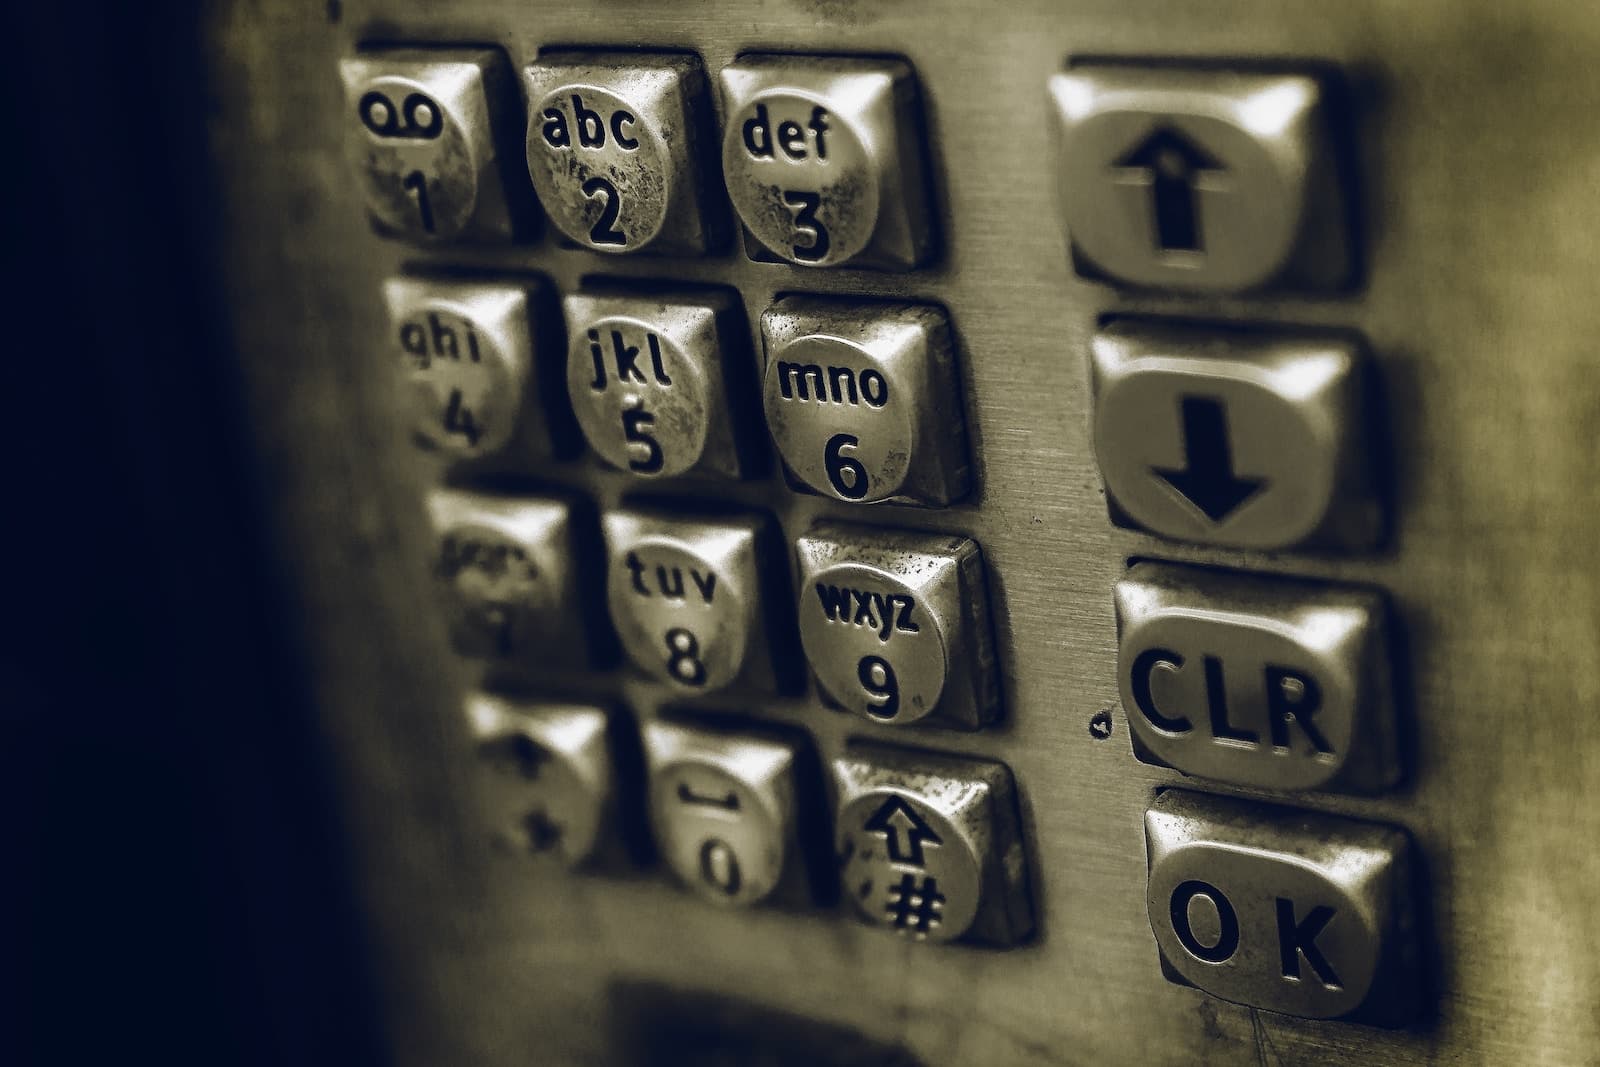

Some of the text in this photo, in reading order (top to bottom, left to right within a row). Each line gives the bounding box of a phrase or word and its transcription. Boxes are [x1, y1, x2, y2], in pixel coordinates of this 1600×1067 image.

[543, 94, 639, 149] abc
[743, 104, 830, 162] def
[403, 171, 436, 234] 1
[582, 177, 626, 245] 2
[784, 190, 830, 262] 3
[401, 312, 481, 370] ghi
[588, 328, 671, 390] jkl
[778, 361, 888, 408] mno
[445, 387, 481, 446] 4
[621, 407, 664, 474] 5
[824, 433, 869, 500] 6
[626, 552, 716, 604] tuv
[816, 583, 920, 642] wxyz
[666, 627, 707, 686] 8
[857, 655, 899, 720] 9
[1131, 647, 1336, 758] CLR
[886, 873, 945, 933] #
[1170, 880, 1344, 990] OK
